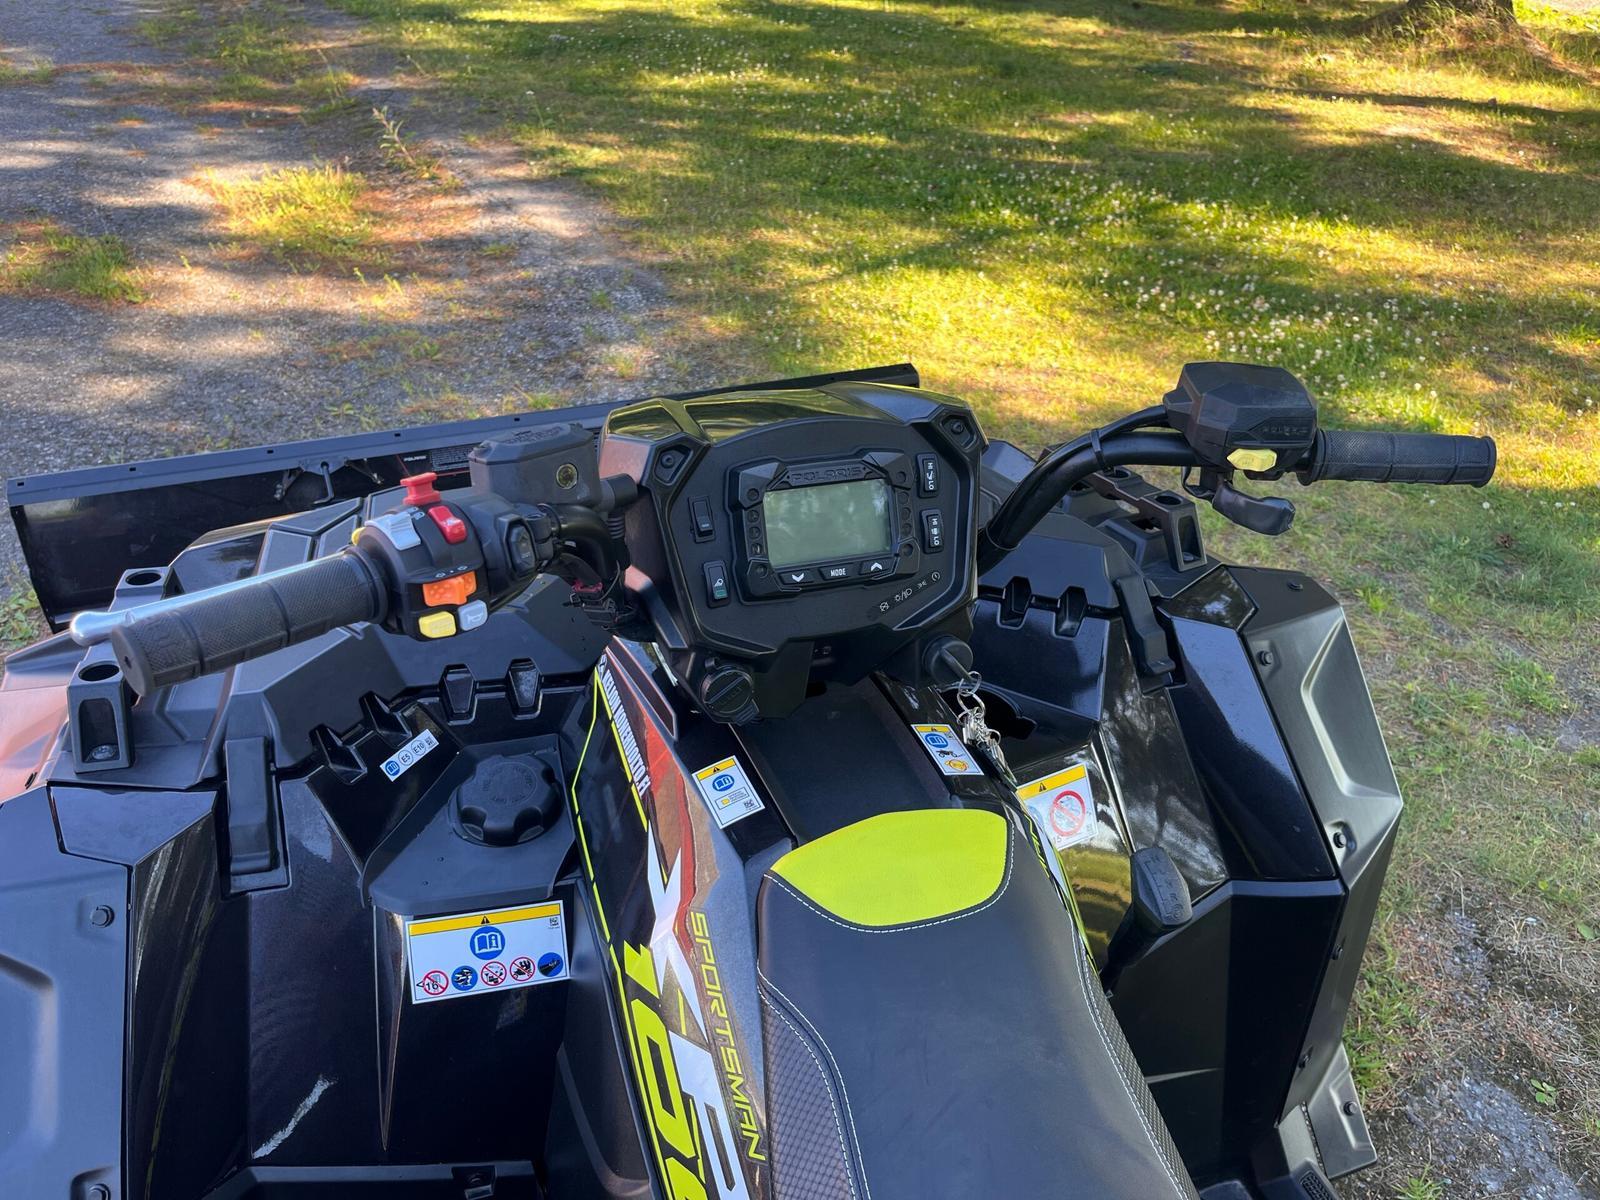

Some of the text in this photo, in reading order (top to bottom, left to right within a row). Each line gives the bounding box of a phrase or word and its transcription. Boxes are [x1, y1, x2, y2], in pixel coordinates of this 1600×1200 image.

[830, 567, 847, 577] MODE
[401, 742, 425, 763] E5 E10
[690, 911, 766, 1161] SPORTSMAN
